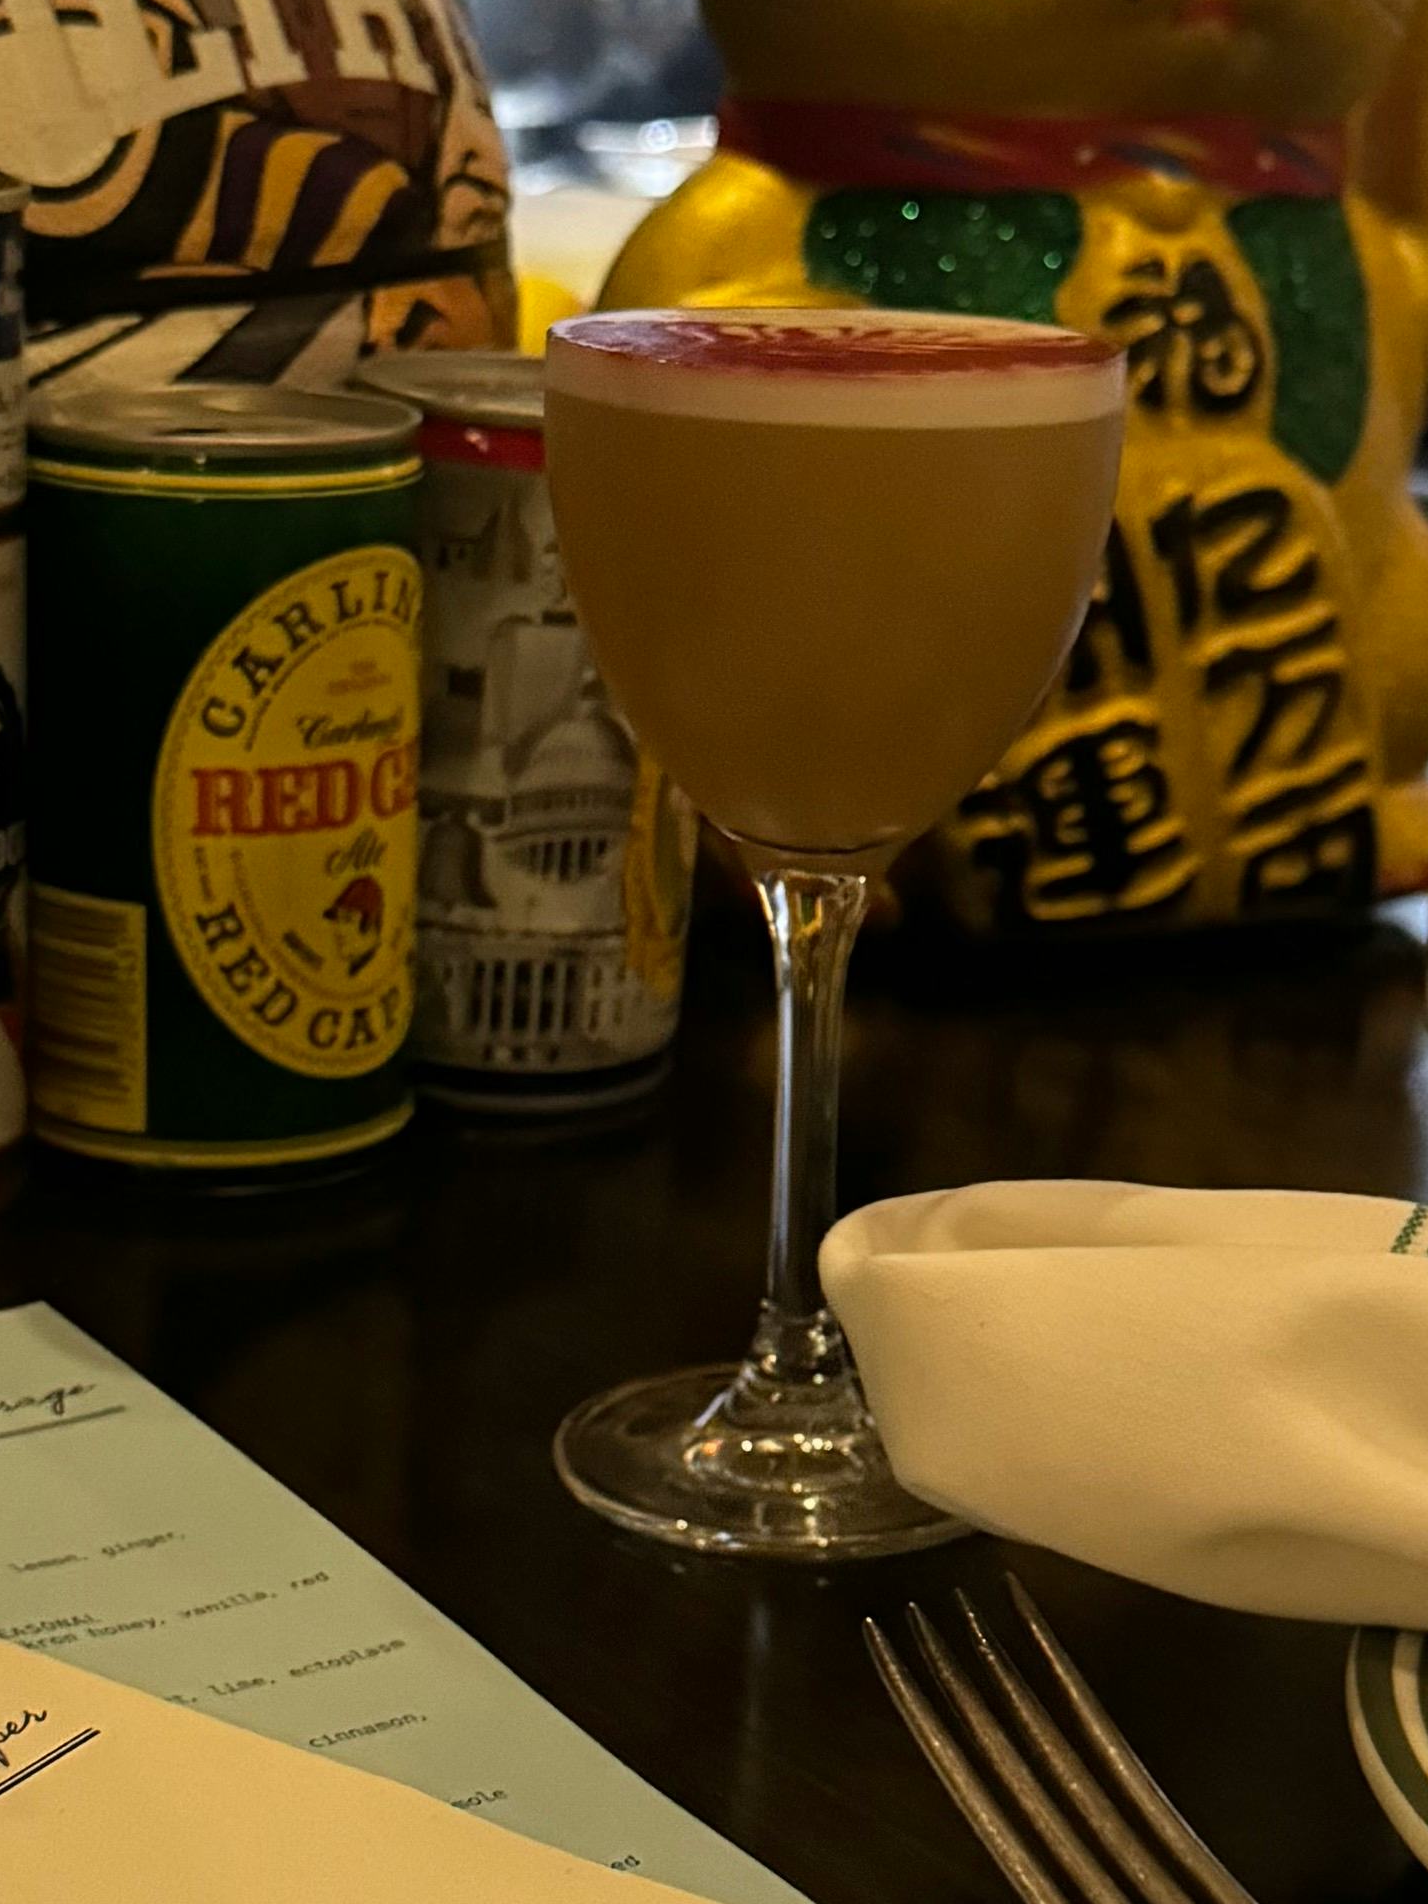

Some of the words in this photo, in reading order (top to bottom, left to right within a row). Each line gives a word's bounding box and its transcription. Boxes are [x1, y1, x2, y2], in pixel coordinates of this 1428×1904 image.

[200, 568, 425, 738] CARLIN
[191, 760, 365, 836] RED
[326, 829, 386, 875] Ale
[197, 901, 298, 1030] RED
